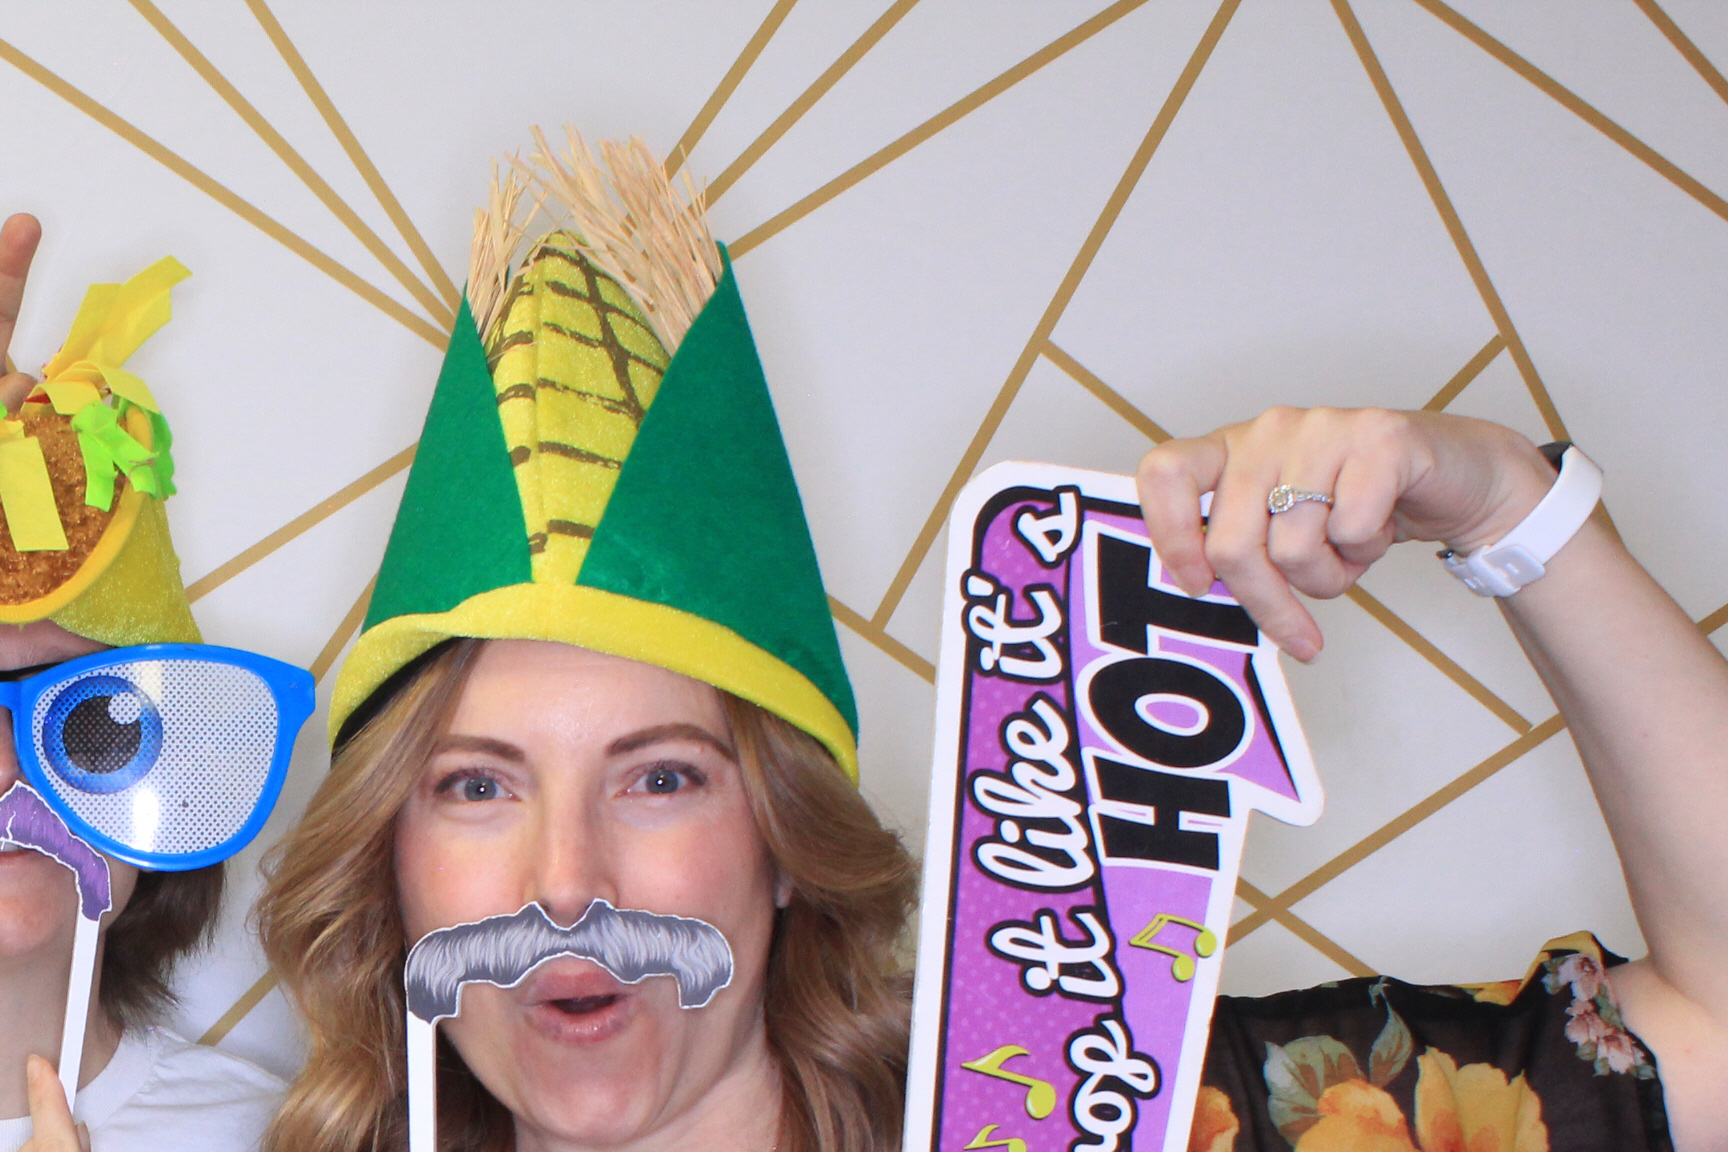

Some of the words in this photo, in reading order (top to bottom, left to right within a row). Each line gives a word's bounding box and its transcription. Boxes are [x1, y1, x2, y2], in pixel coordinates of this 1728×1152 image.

[965, 488, 1079, 681] it's
[971, 697, 1096, 889] like
[1087, 530, 1260, 872] HOT
[989, 910, 1121, 1001] it
